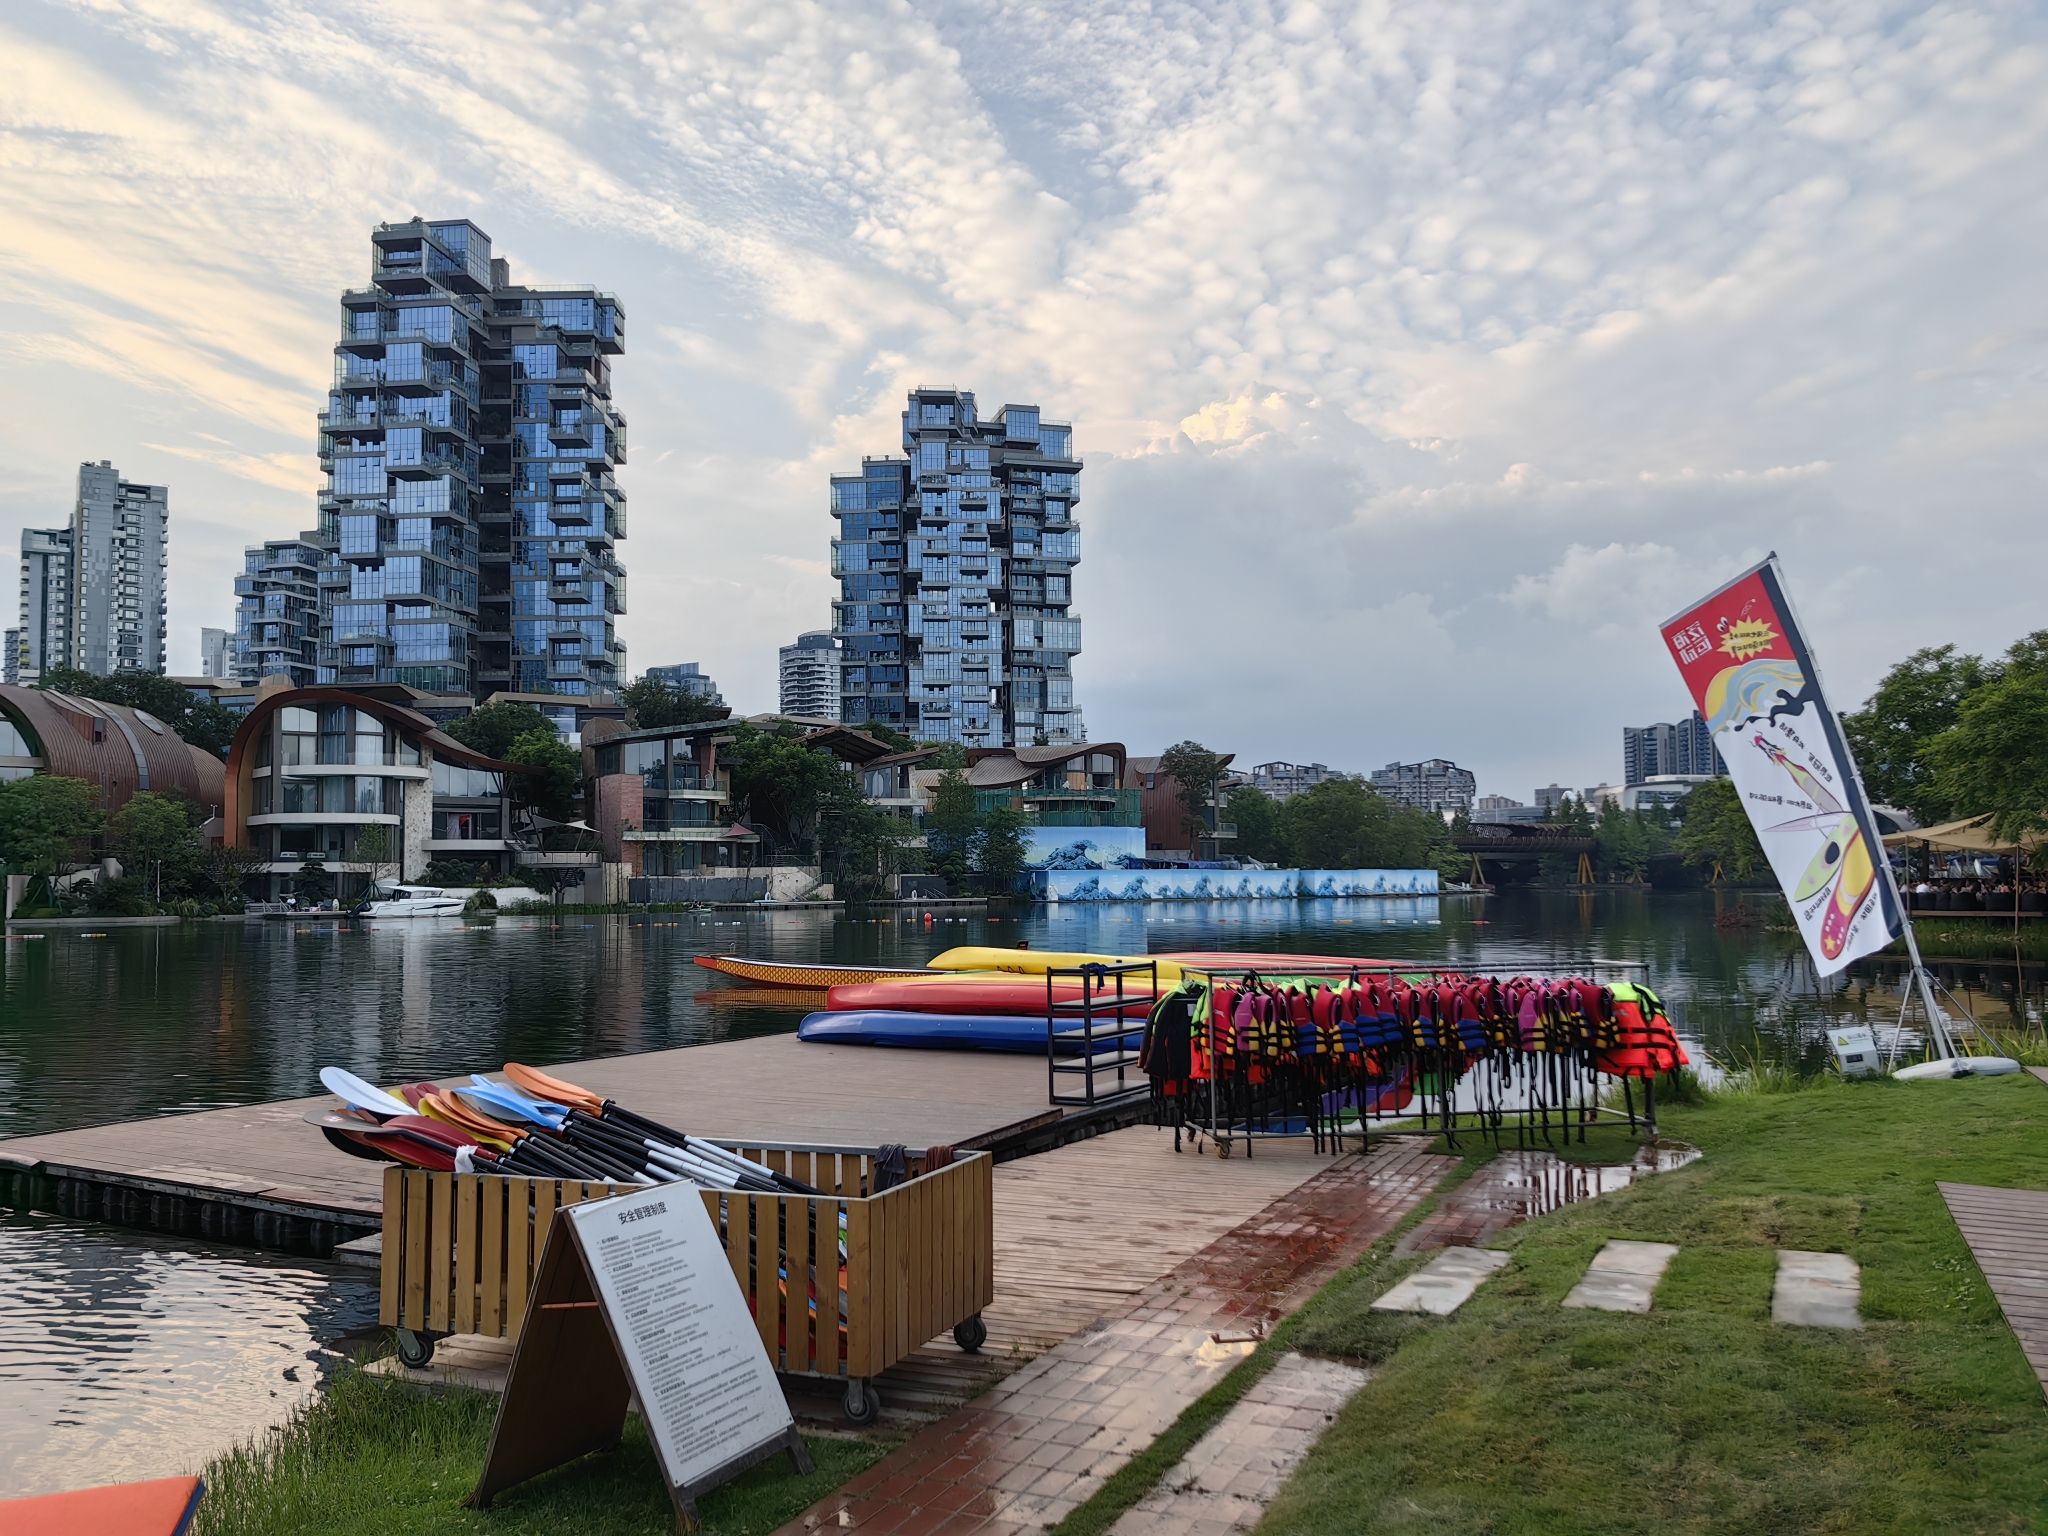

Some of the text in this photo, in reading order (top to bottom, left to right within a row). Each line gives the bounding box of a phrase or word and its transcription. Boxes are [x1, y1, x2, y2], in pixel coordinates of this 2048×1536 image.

[618, 1201, 668, 1225] 安全管理制度
